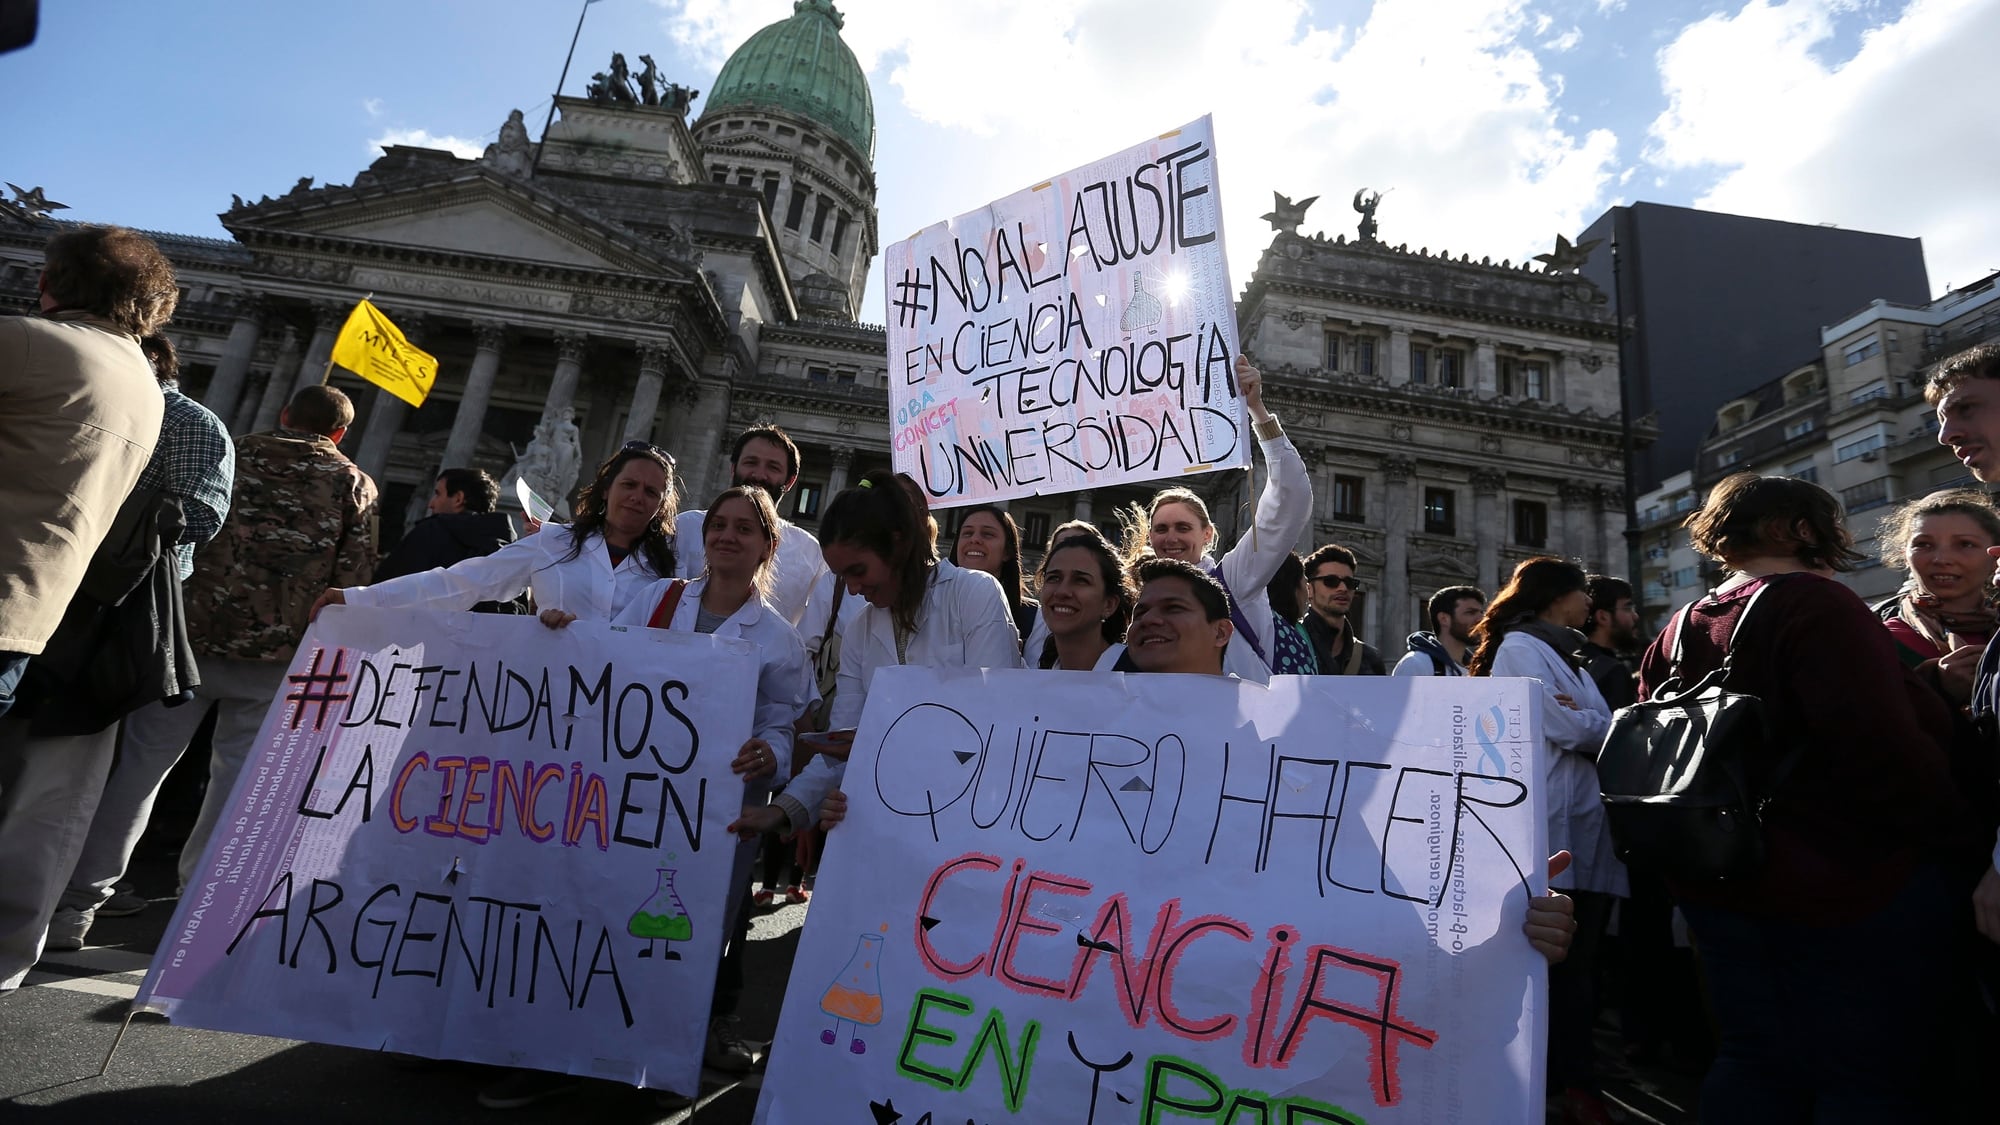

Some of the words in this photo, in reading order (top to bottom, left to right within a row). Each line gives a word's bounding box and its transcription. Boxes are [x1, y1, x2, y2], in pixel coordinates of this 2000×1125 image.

[997, 222, 1061, 304] AL
[1064, 141, 1216, 276] AJUSTE
[895, 396, 958, 452] CONICET
[906, 337, 943, 385] EN
[297, 743, 372, 823] LA
[389, 751, 610, 850] CIENCIA
[613, 773, 708, 852] EN
[874, 702, 1186, 855] QUIERO
[1204, 742, 1534, 908] HACER
[225, 872, 634, 1028] ARGENTINA
[913, 853, 1438, 1107] CIENCIA
[897, 988, 1040, 1113] EN
